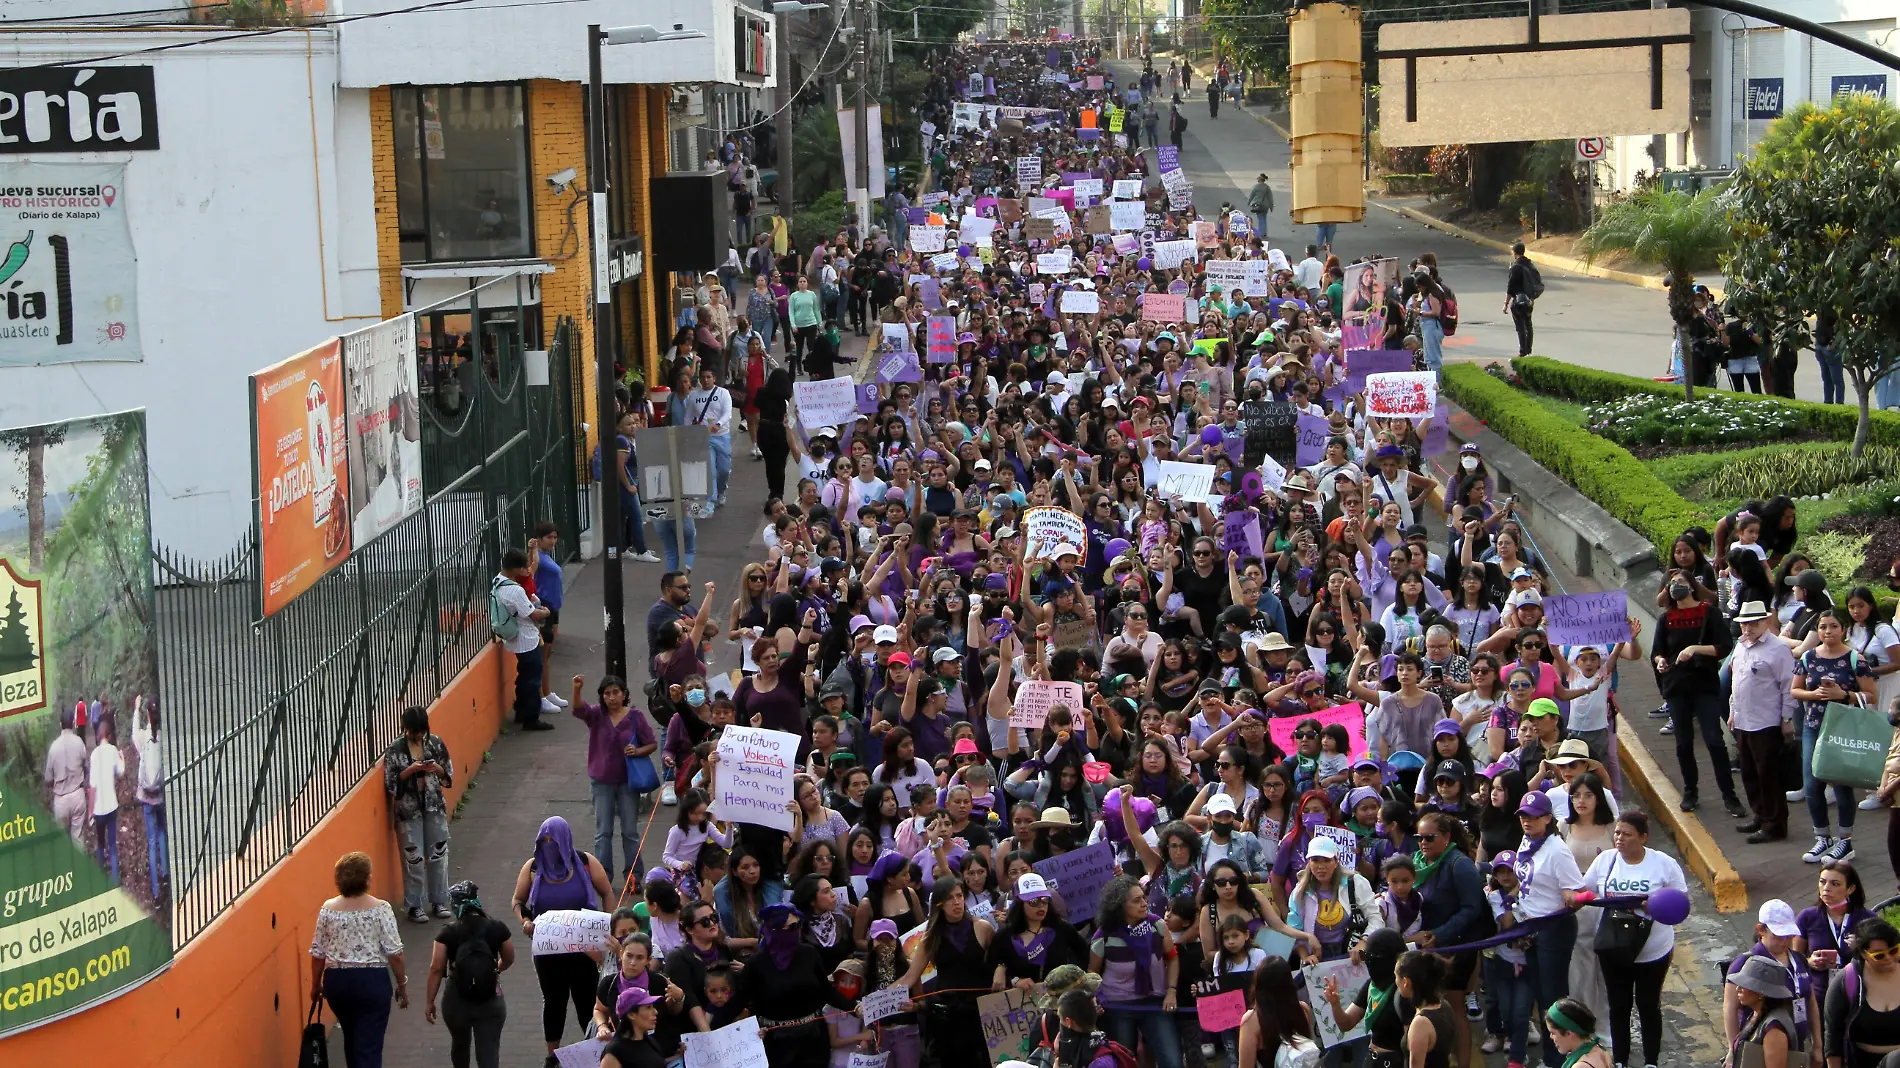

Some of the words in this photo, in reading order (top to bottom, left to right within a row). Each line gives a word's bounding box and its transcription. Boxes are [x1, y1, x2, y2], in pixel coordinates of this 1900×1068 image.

[1752, 86, 1781, 111] telcel
[37, 185, 101, 197] sucursal
[26, 195, 101, 208] HISTÓRICO
[52, 211, 63, 220] de
[66, 210, 101, 221] Xalapa)
[695, 395, 718, 404] HUO
[1246, 404, 1259, 415] No
[1262, 404, 1285, 415] sabes
[1551, 596, 1580, 618] NO
[1054, 687, 1072, 698] TE
[725, 726, 735, 738] Por
[737, 735, 748, 743] un
[750, 732, 780, 750] futuro
[1828, 735, 1881, 751] PULL&BEAR
[720, 743, 734, 754] Sin
[743, 746, 785, 767] Violencia
[736, 762, 783, 779] Igualdad
[733, 775, 760, 789] Para
[766, 784, 785, 796] mis
[724, 791, 784, 814] Hermanas
[1606, 878, 1650, 892] AdeS
[3, 871, 74, 917] grupos
[29, 922, 54, 952] de
[60, 905, 118, 945] Xalapa
